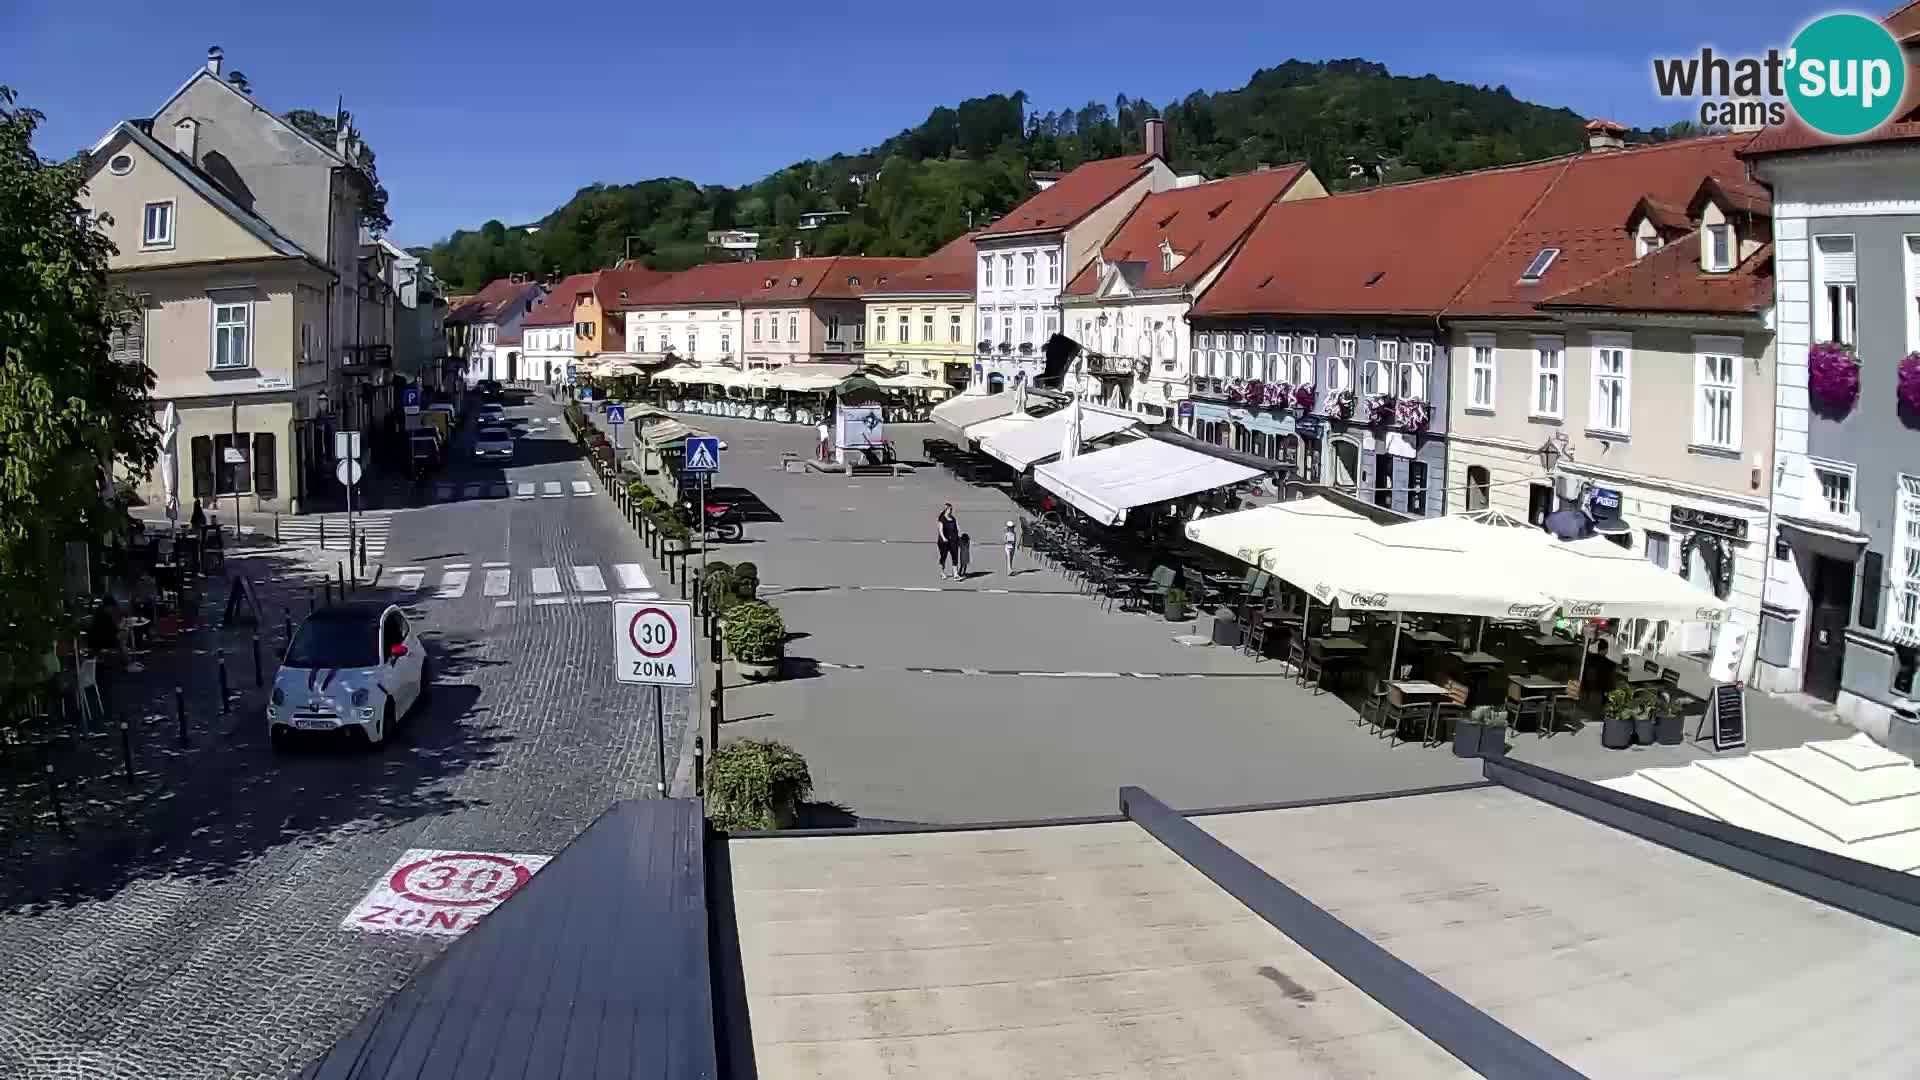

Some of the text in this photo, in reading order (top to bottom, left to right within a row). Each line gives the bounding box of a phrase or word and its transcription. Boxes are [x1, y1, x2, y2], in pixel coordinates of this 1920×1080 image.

[642, 623, 666, 645] 30
[632, 661, 677, 678] ZONA
[418, 866, 503, 893] 30
